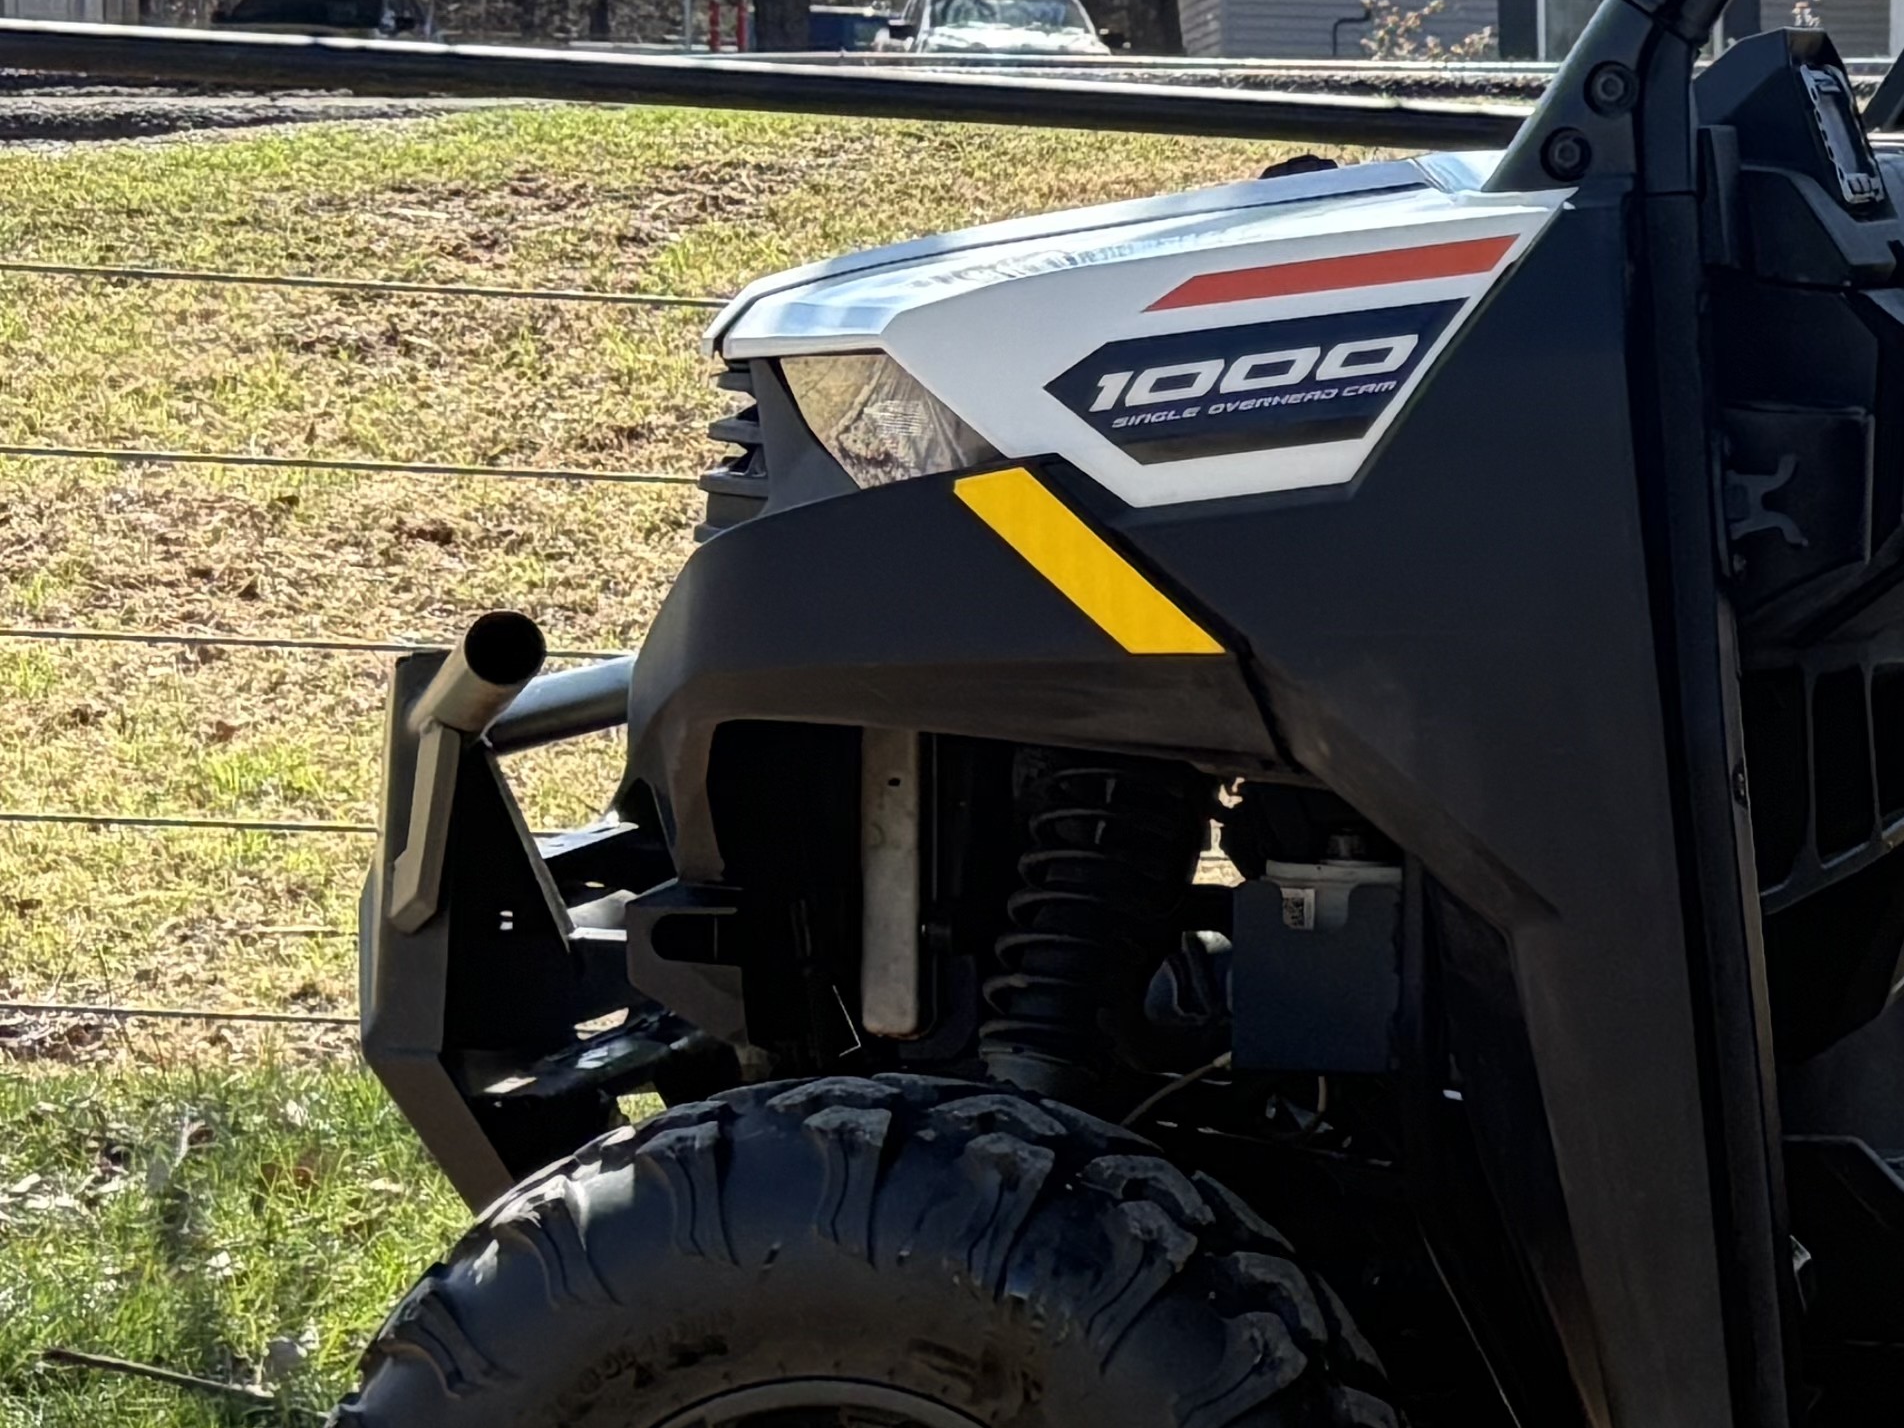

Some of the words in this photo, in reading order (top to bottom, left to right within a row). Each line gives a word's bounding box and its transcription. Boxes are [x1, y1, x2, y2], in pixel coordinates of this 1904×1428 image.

[1088, 334, 1419, 412] 1000
[1111, 406, 1201, 429] SINGLE
[1207, 387, 1339, 415] OVERHEAD
[1341, 380, 1398, 397] CAM
